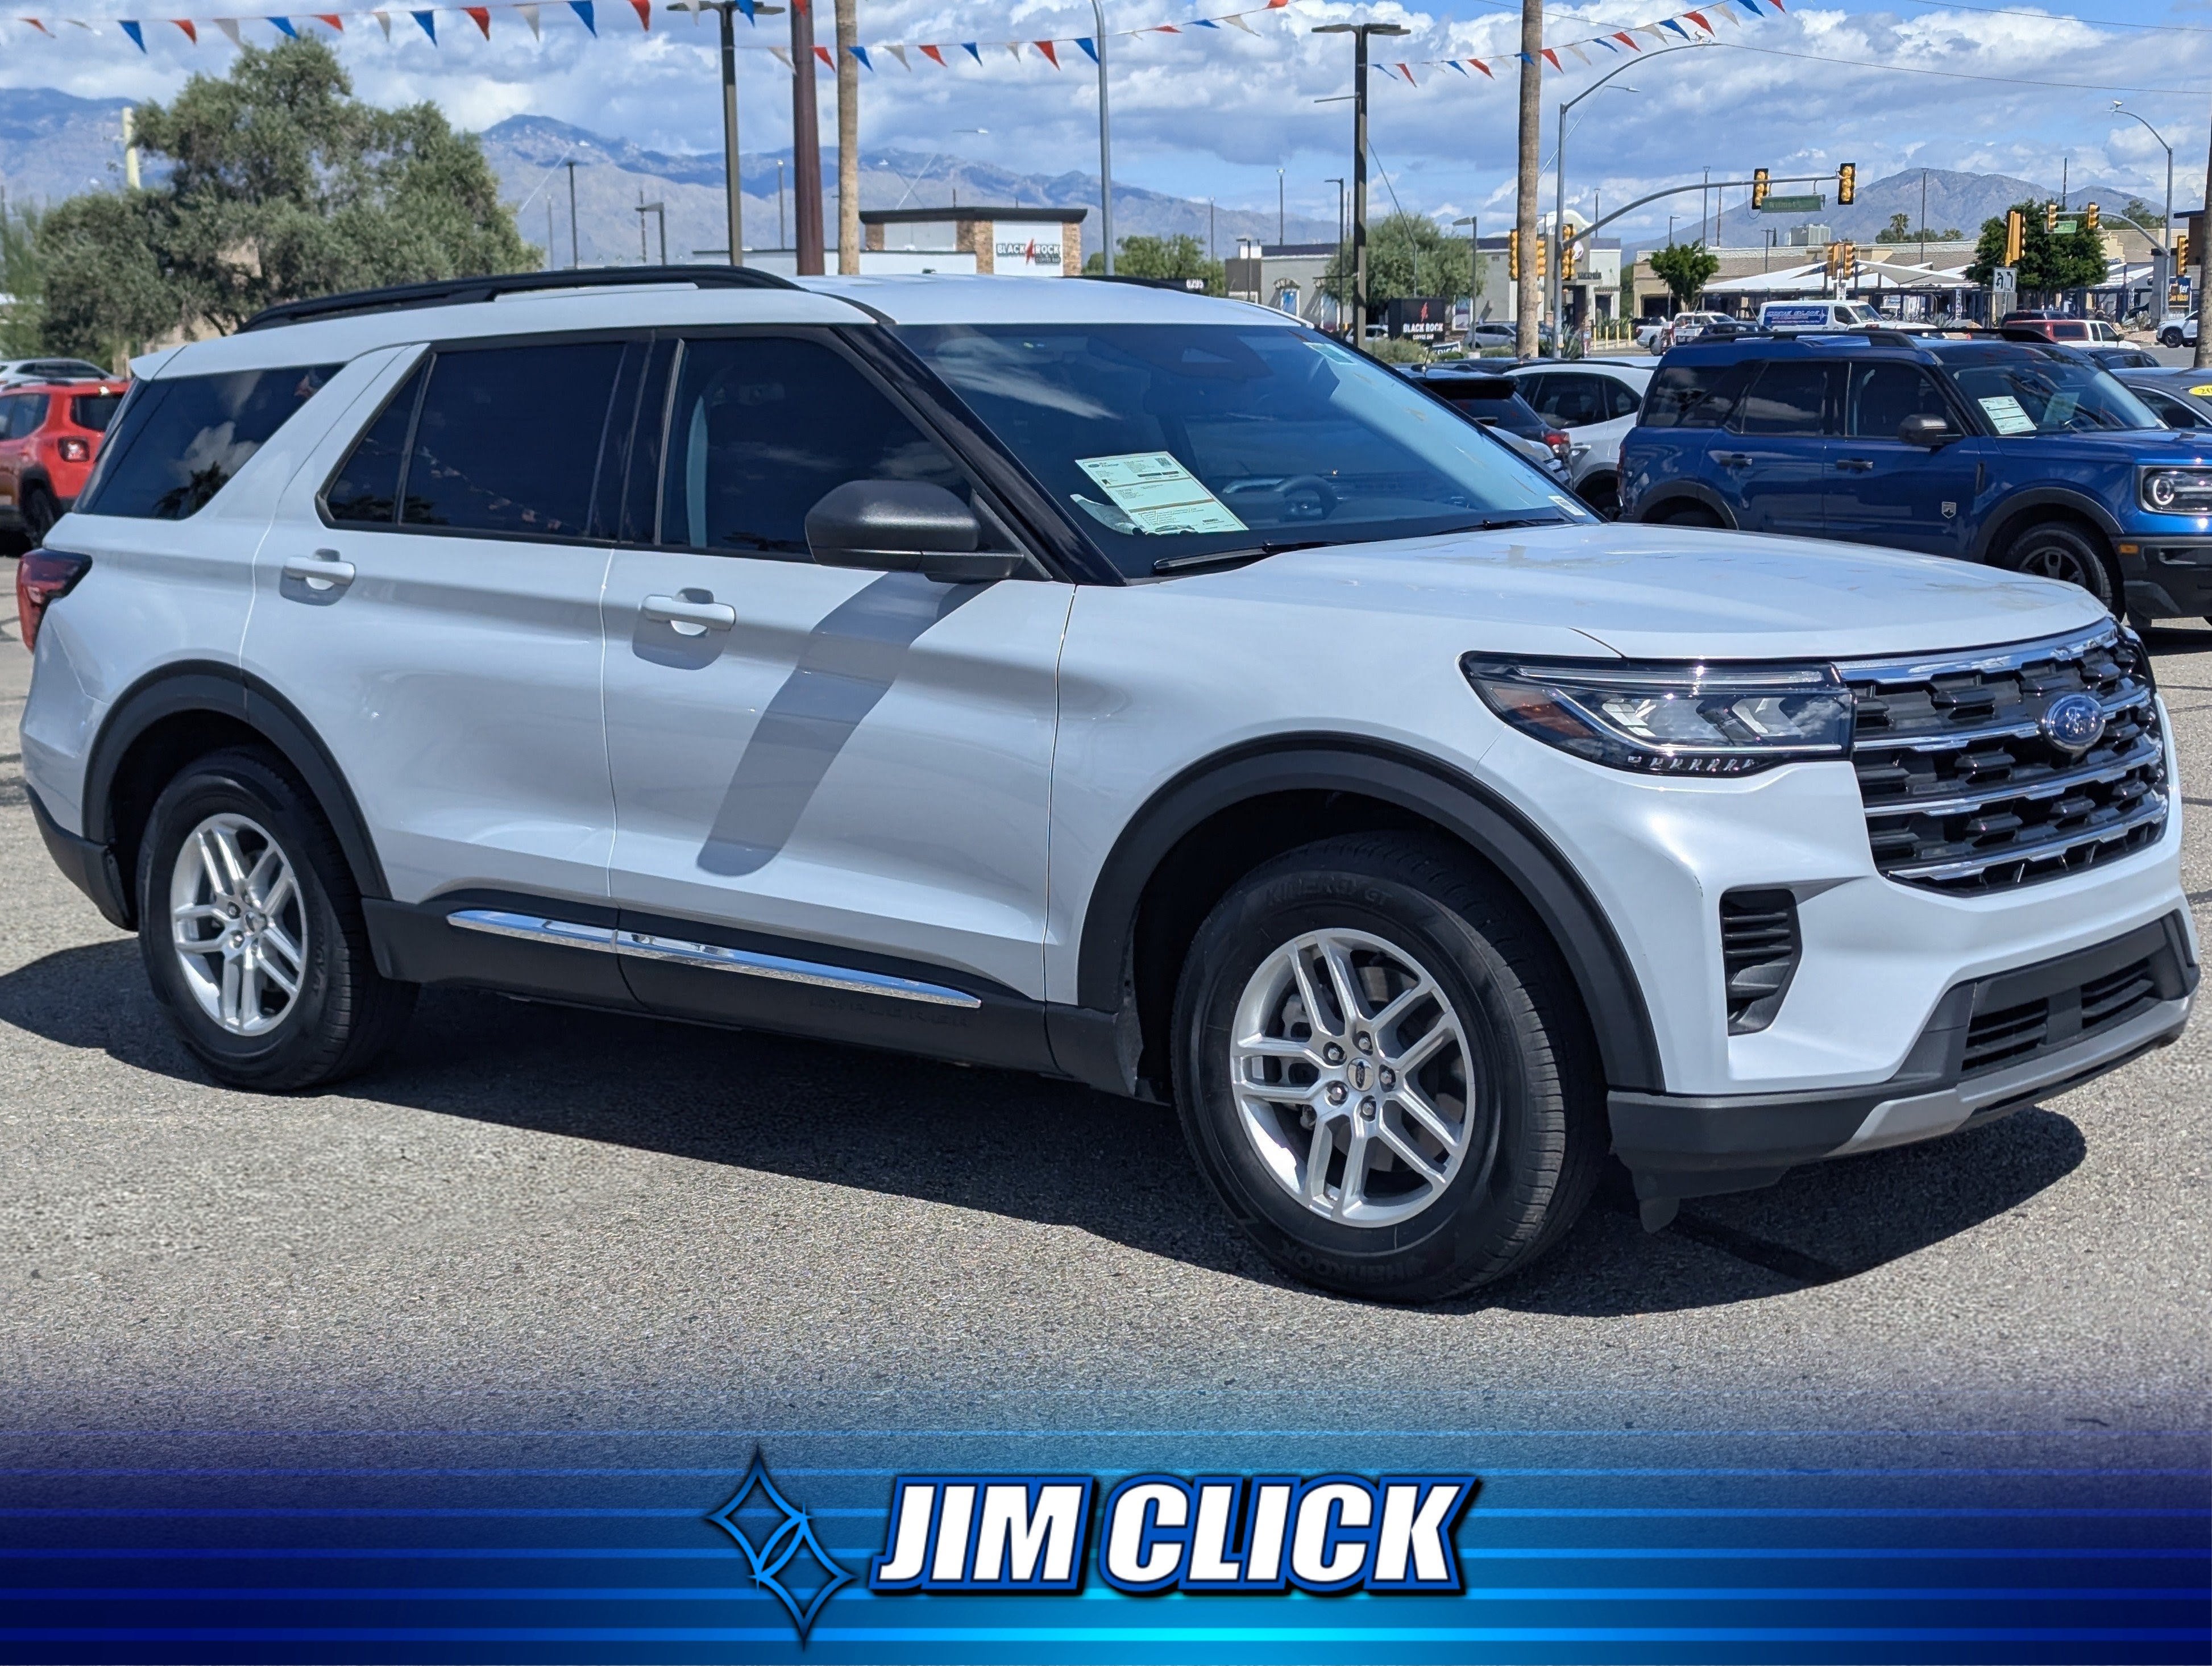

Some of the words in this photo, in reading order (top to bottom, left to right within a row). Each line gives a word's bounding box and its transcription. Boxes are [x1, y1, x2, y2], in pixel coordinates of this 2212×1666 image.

[997, 244, 1026, 255] BLACK
[1035, 244, 1060, 255] ROCK
[1403, 322, 1424, 333] BLACK
[1425, 322, 1443, 331] ROCK
